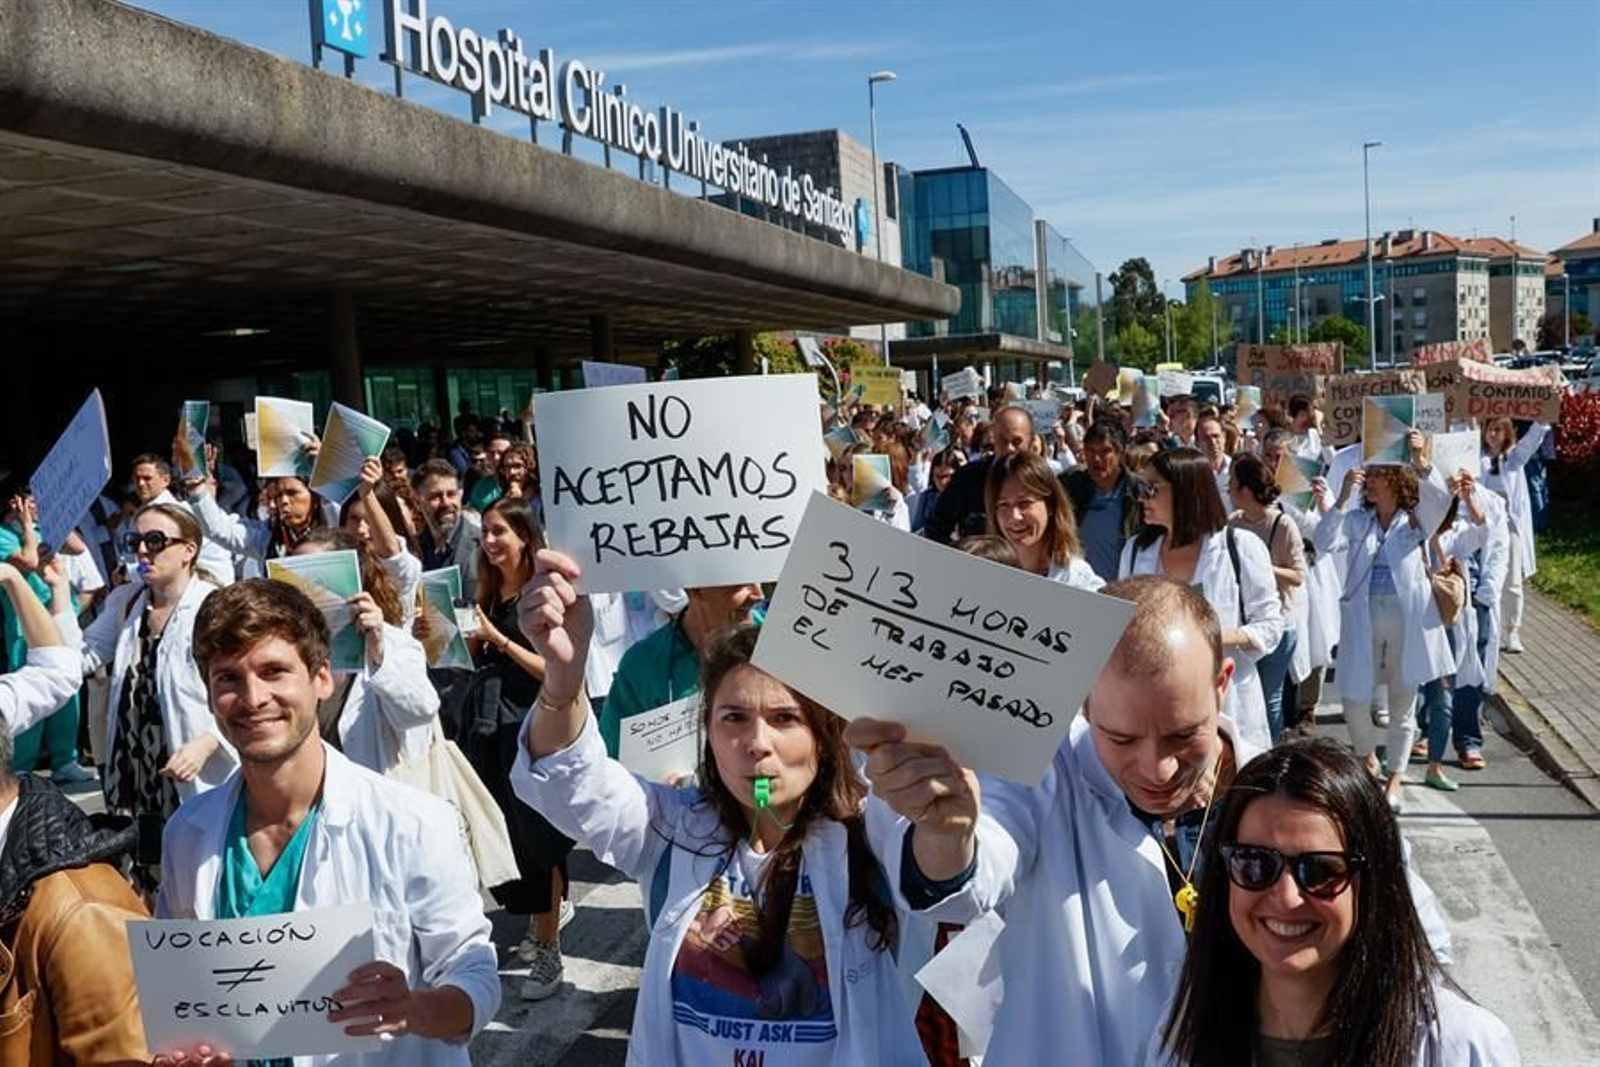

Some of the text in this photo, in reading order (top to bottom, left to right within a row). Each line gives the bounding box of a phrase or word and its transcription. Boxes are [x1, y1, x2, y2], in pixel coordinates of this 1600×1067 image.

[390, 0, 855, 251] Hospital Clínico Universitario de Santiago
[1331, 372, 1422, 400] MERECEMOS
[1467, 397, 1544, 417] DIGNOS
[1468, 384, 1553, 401] CONTRATOS
[627, 394, 692, 440] NO
[553, 451, 798, 506] ACEPTAMOS
[590, 512, 791, 563] REBAJAS
[822, 540, 1072, 655] 313 HORAS
[801, 584, 1016, 679] DE TRABAJO
[792, 615, 1053, 729] EL MES PASADO
[144, 922, 317, 950] VOCACIÓN
[709, 1019, 795, 1043] JUST ASK
